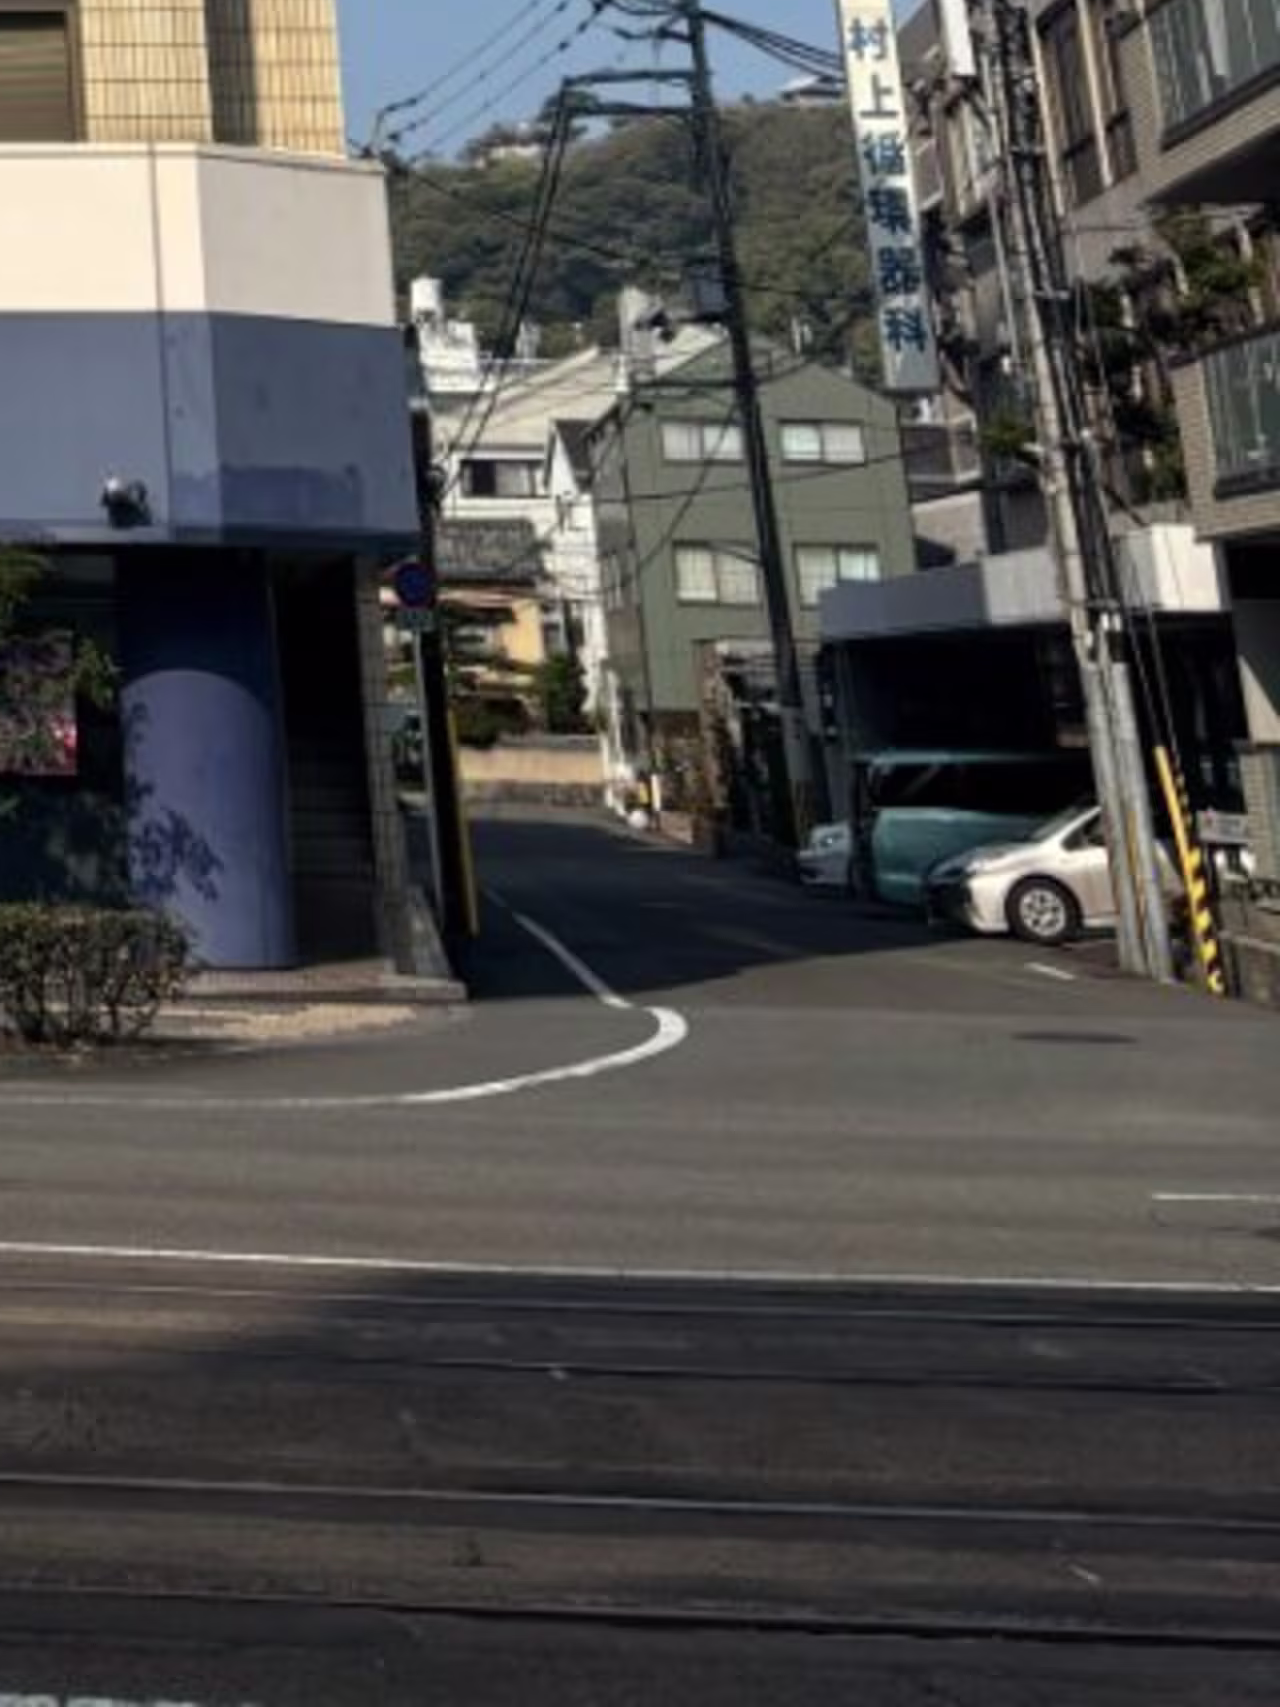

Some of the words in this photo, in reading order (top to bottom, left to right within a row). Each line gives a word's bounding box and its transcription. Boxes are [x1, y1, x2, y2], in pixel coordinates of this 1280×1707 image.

[848, 16, 928, 354] 村上循環器科
